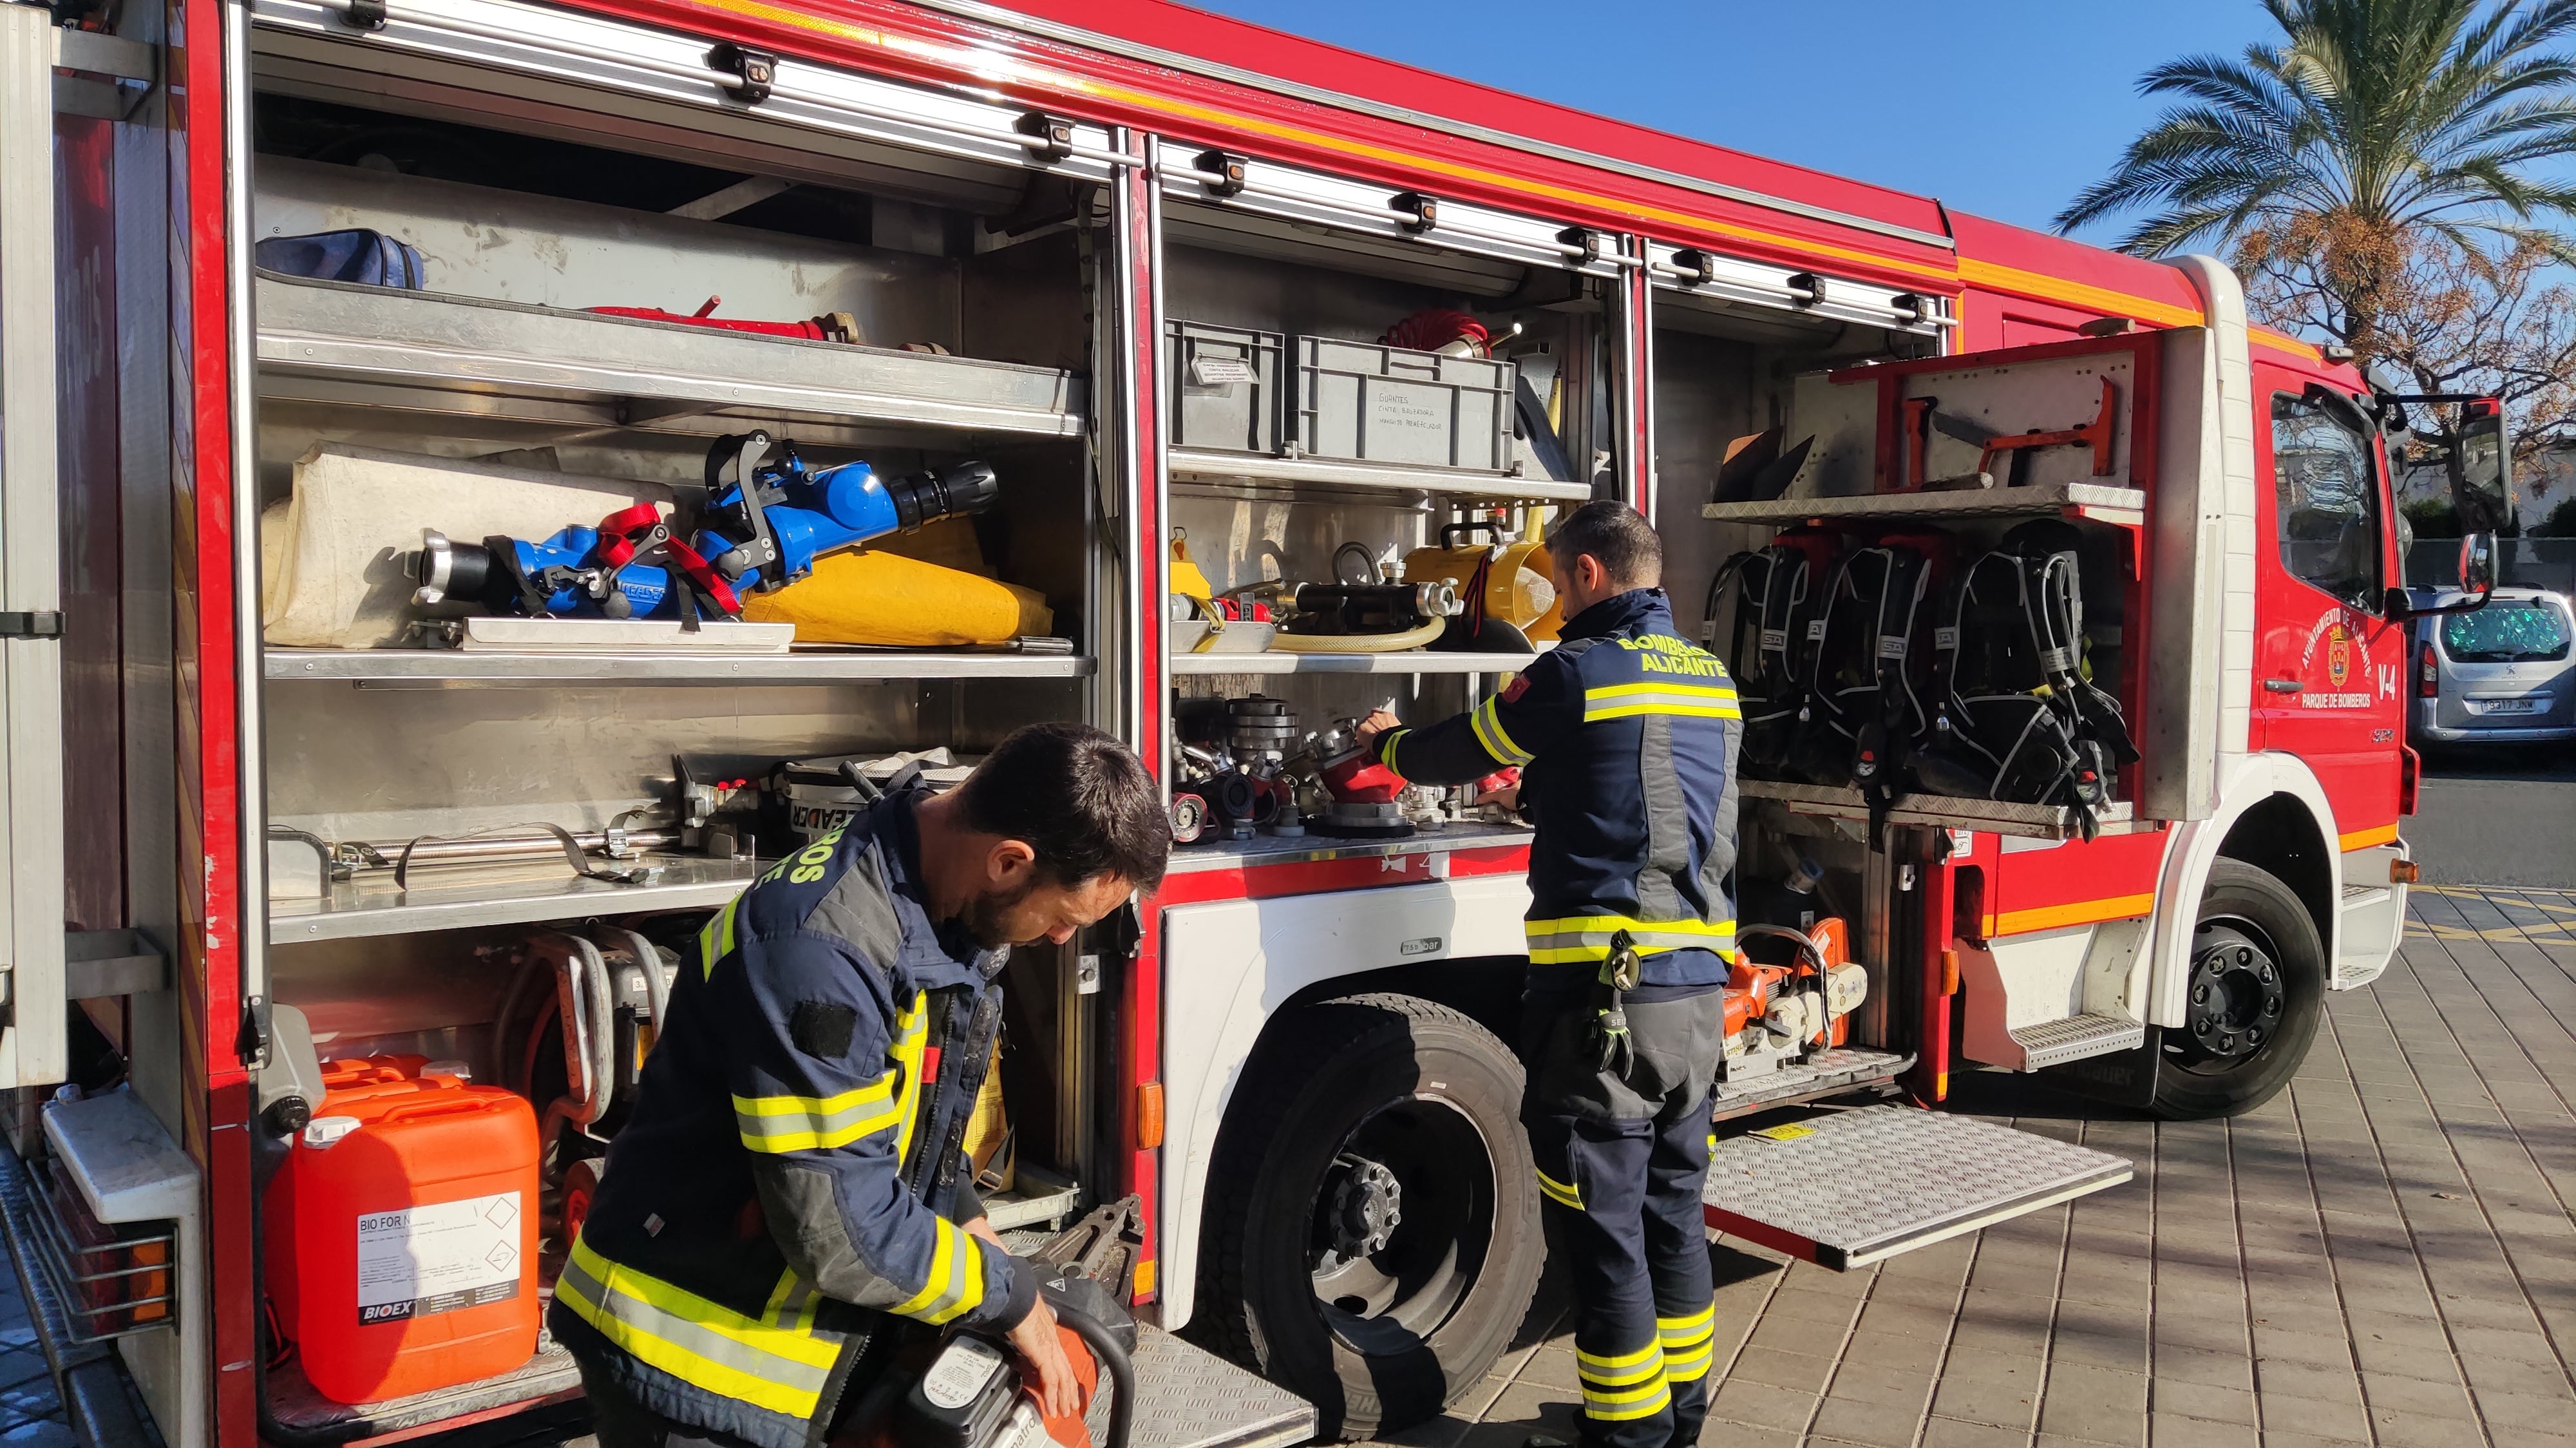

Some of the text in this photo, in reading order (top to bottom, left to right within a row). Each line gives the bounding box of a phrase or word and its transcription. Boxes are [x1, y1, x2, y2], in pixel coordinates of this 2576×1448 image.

[1379, 393, 1408, 404] GUANTES
[2302, 607, 2372, 677] AYUNTAMIENTO DE ALICANTE
[1641, 653, 1728, 678] ALICANTE
[2378, 663, 2396, 701] V-4
[2302, 694, 2371, 709] PARQUE DE BOMBEROS
[361, 1219, 377, 1231] BIO
[381, 1216, 401, 1228] FOR
[363, 1300, 413, 1320] BIOEX
